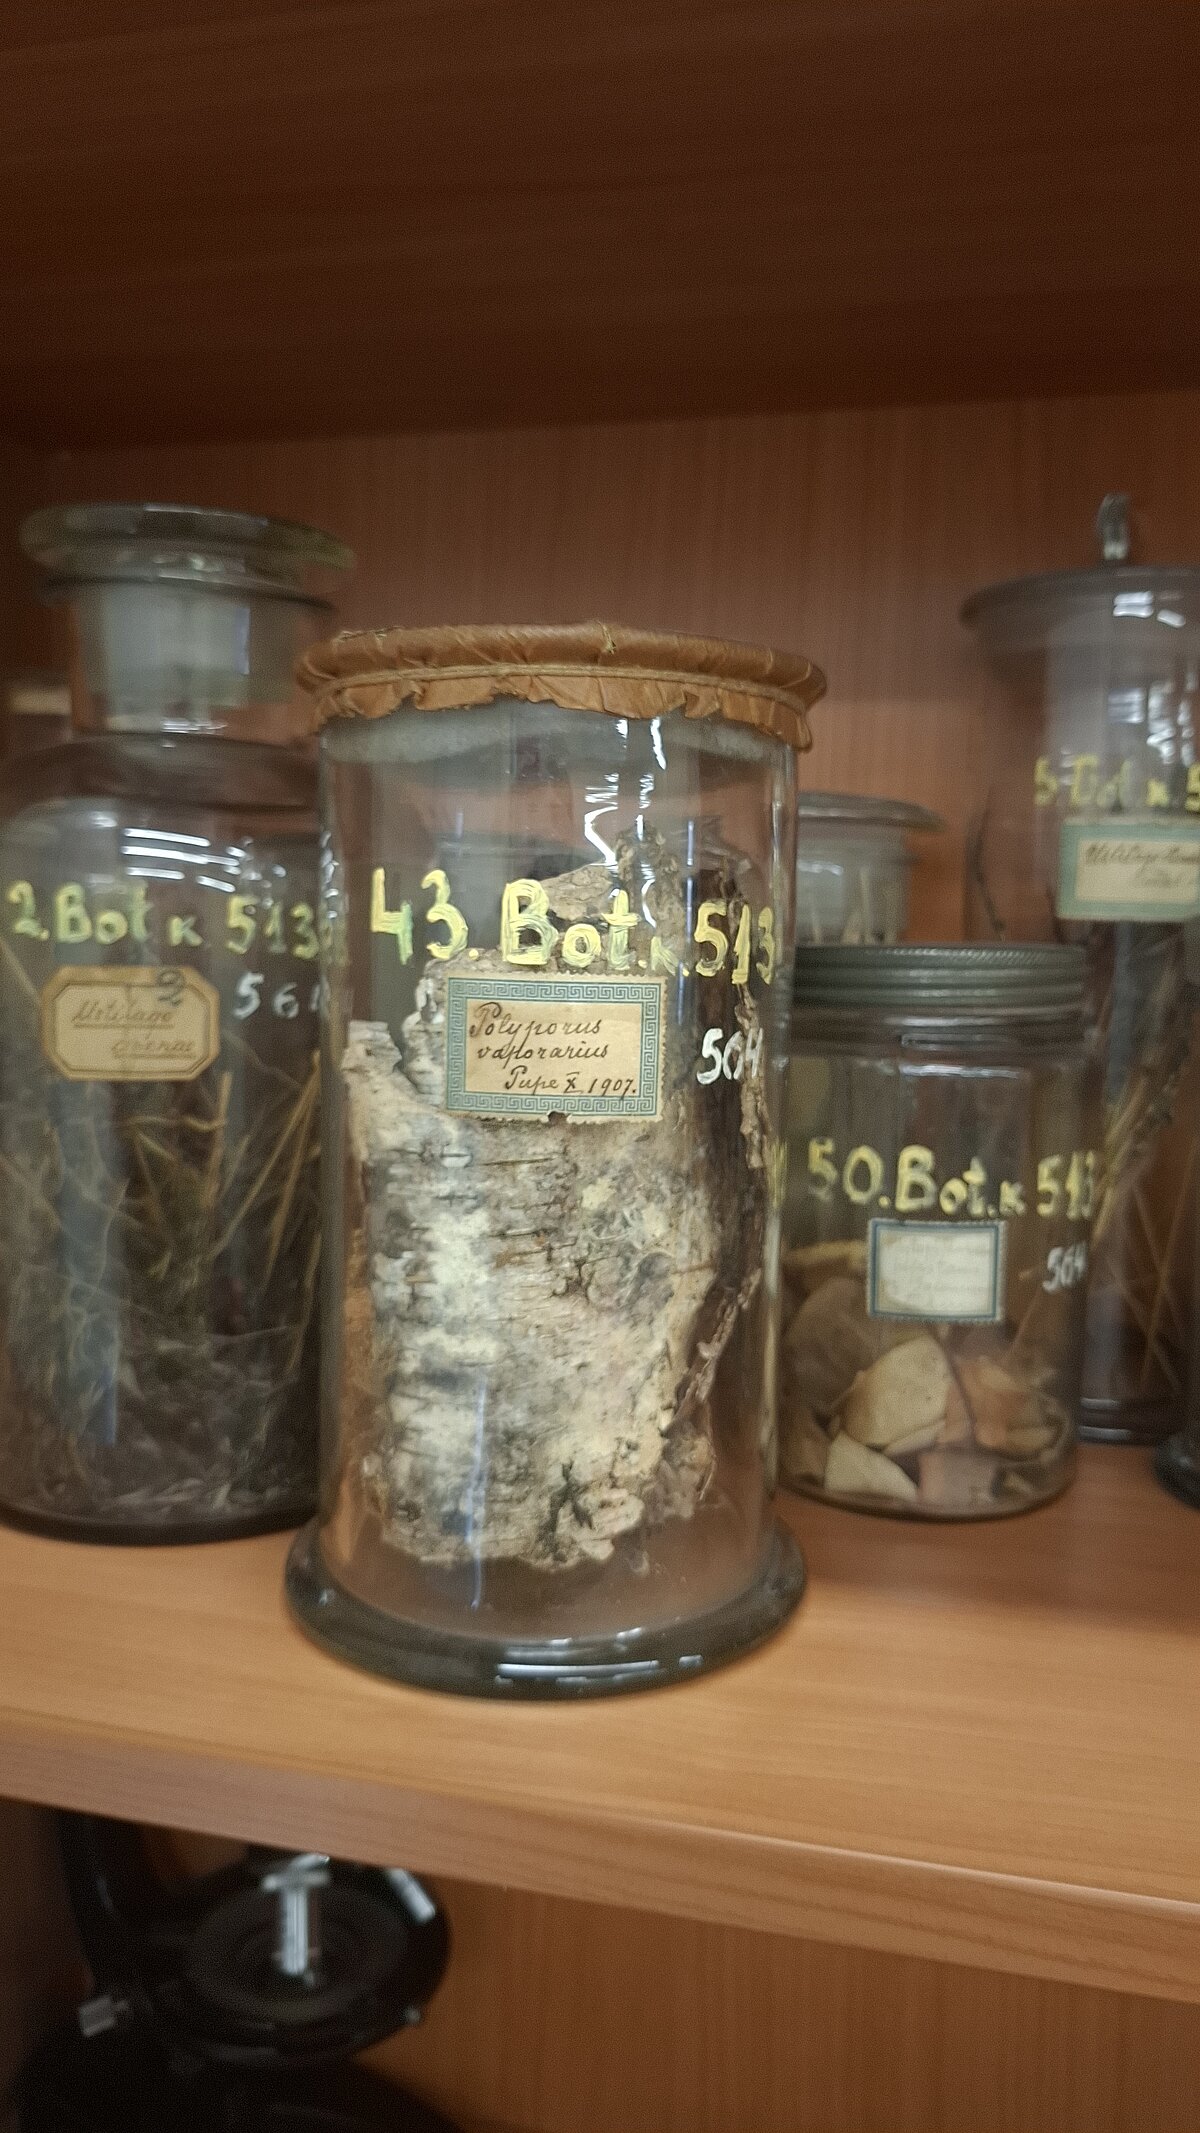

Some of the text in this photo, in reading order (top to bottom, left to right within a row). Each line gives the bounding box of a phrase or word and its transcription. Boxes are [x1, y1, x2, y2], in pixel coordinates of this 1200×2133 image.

[226, 894, 320, 959] 513
[369, 867, 479, 966] 43.
[501, 877, 648, 971] Bot.
[694, 901, 776, 985] 513
[469, 1002, 602, 1054] Polyporus
